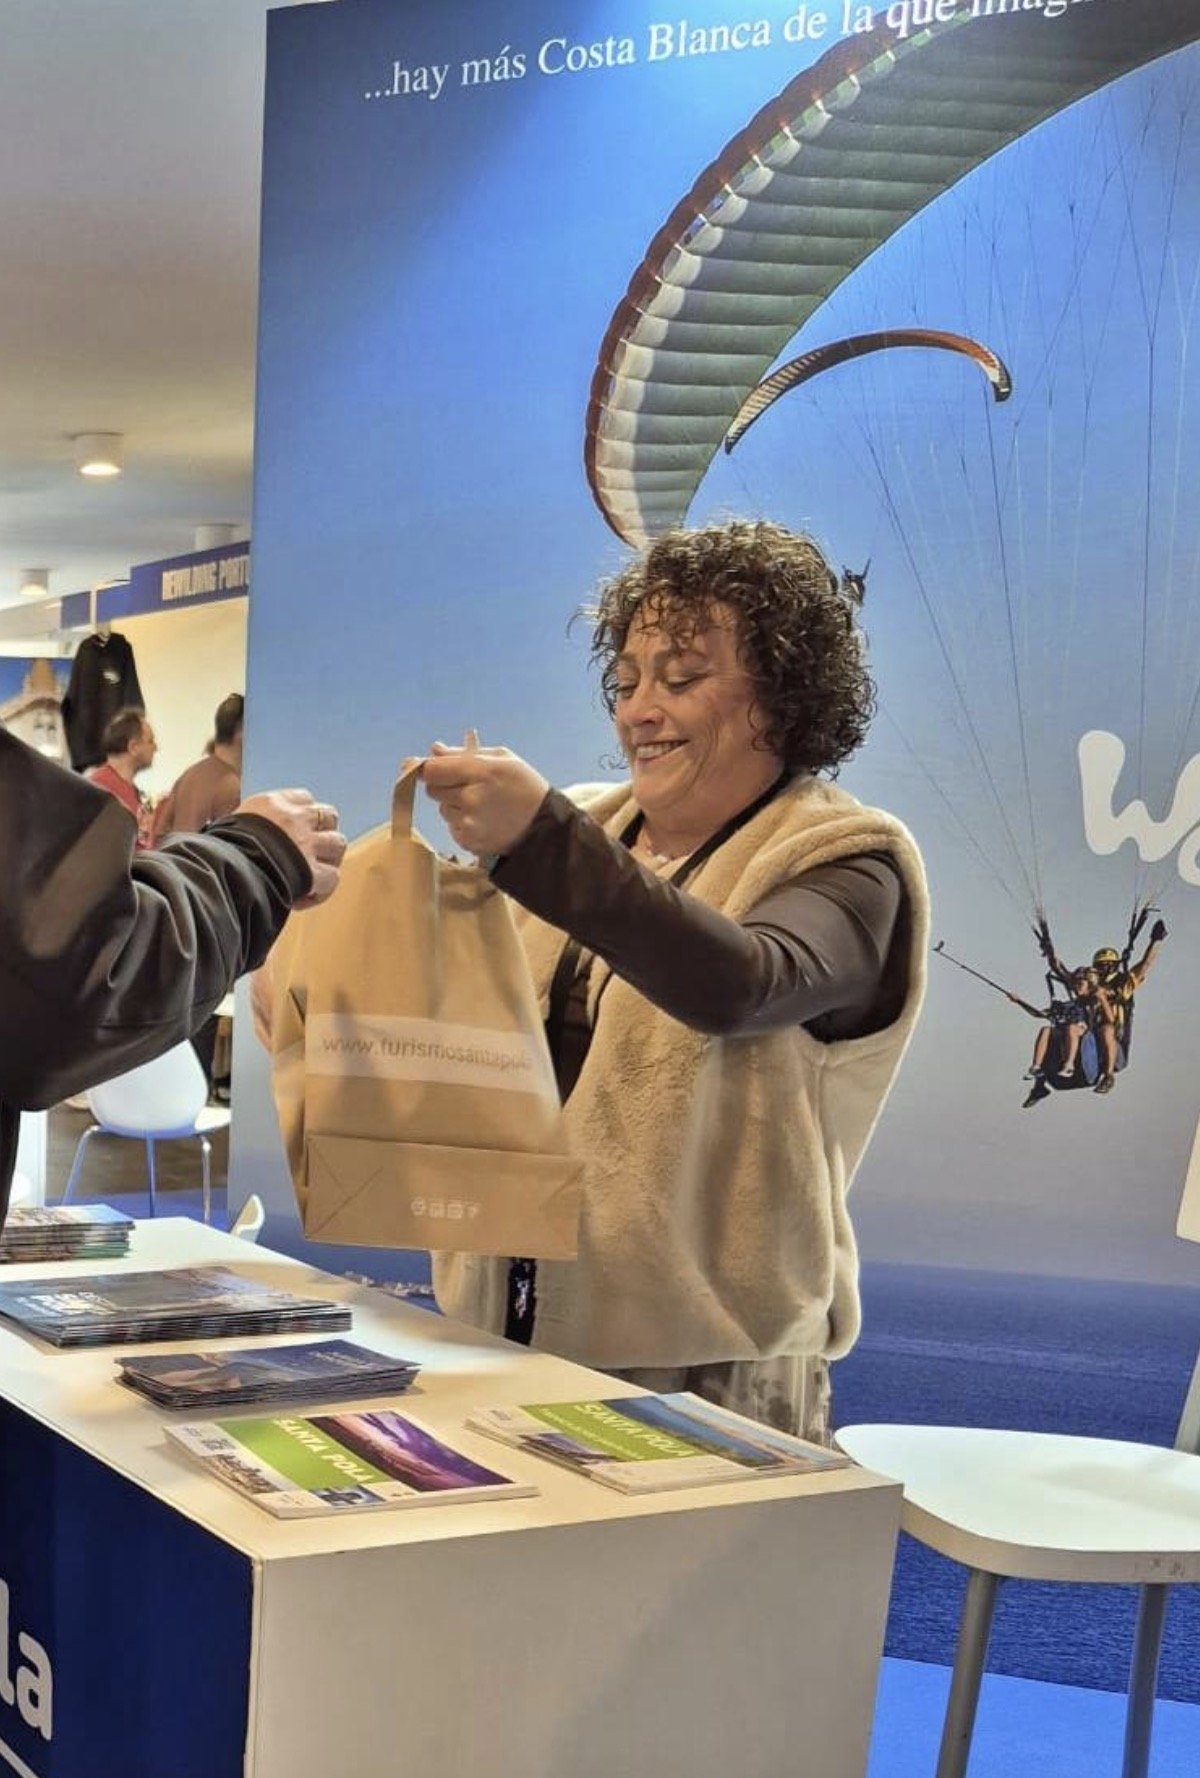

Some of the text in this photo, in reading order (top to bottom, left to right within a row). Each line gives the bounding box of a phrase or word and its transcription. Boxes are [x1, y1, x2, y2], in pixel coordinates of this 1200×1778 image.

[460, 44, 527, 86] más
[537, 35, 637, 75] Costa
[647, 18, 772, 62] Blanca
[783, 4, 828, 42] de
[840, 0, 874, 34] la
[885, 0, 957, 38] que
[273, 1418, 376, 1482] SANTA POLA
[574, 1403, 644, 1435] SANTA
[633, 1433, 696, 1457] POLA
